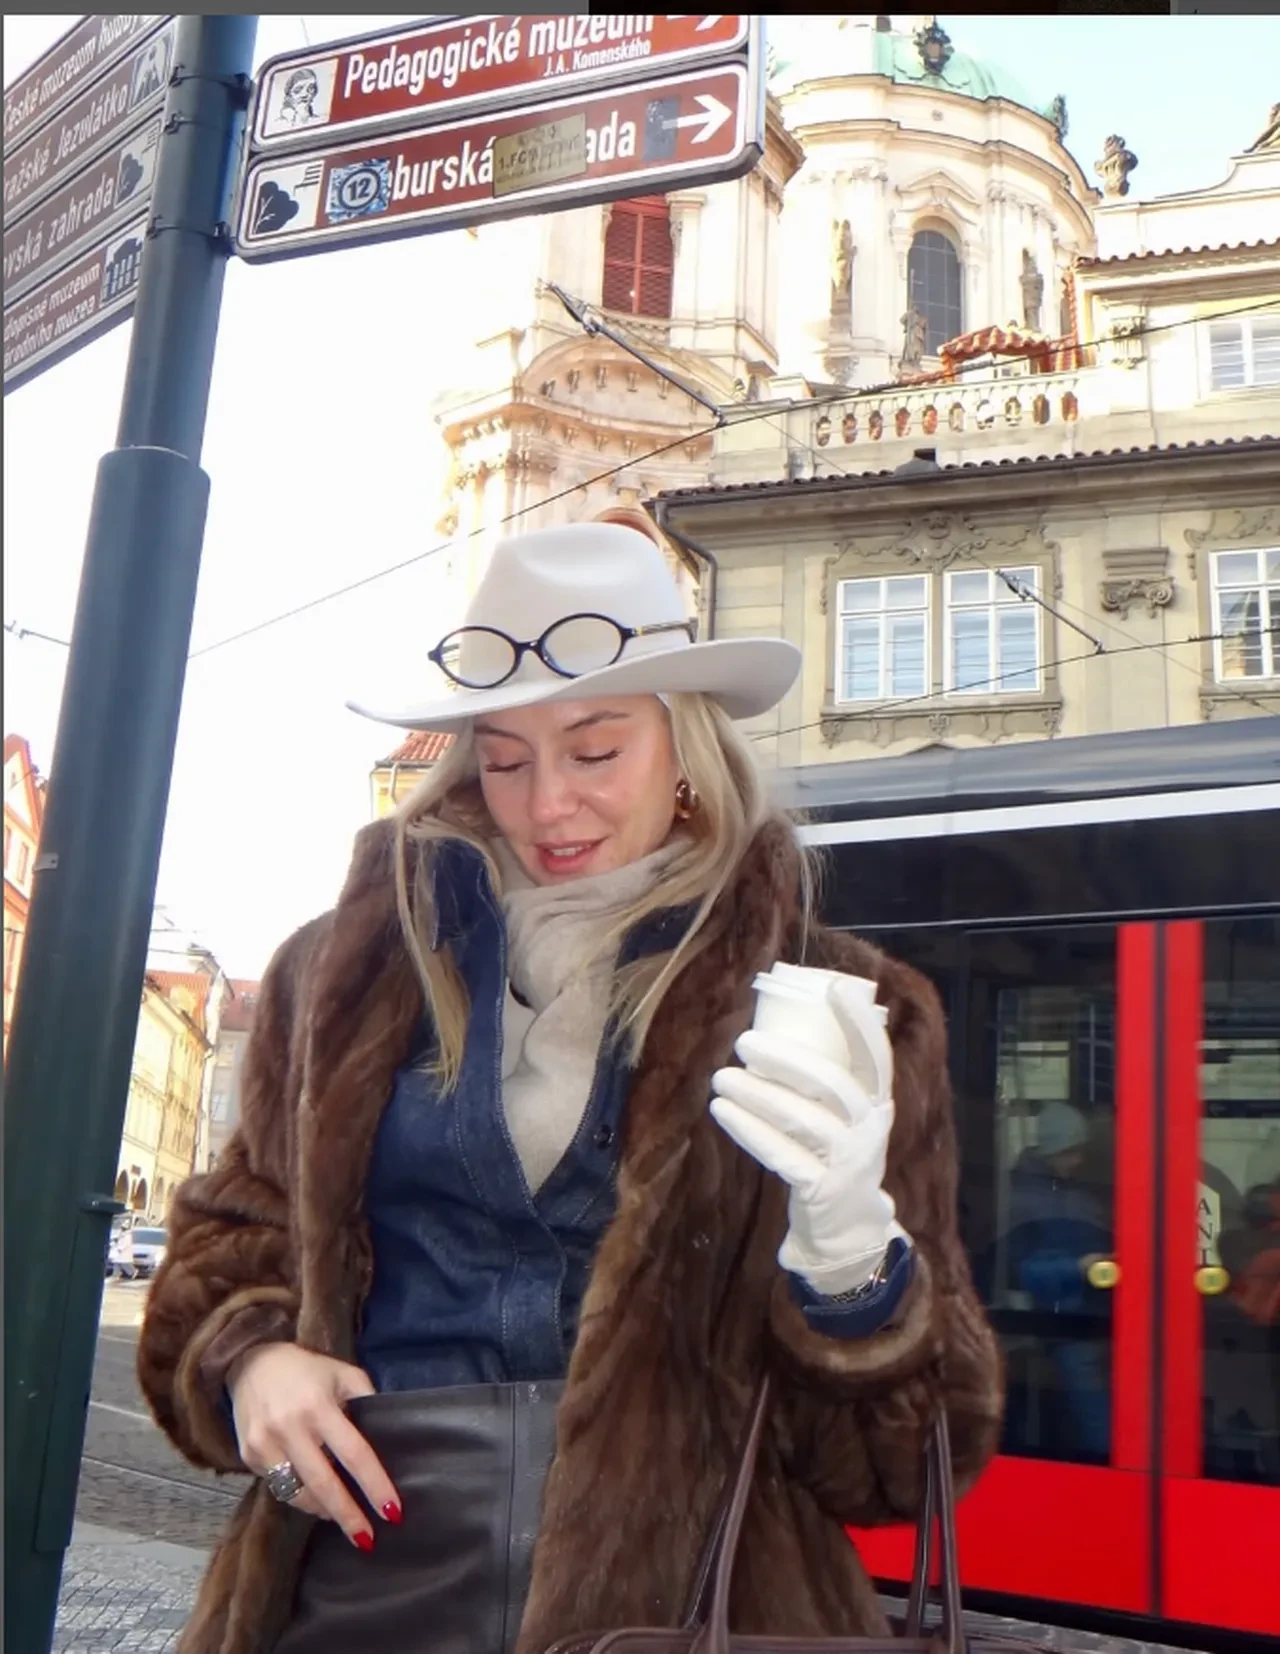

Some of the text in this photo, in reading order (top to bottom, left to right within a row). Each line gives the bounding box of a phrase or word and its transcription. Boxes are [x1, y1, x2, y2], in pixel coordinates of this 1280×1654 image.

[343, 16, 522, 98] Pedagogické
[573, 36, 651, 71] Komenského
[347, 178, 371, 201] 12
[386, 136, 497, 202] burská
[47, 172, 114, 249] zahrada
[48, 262, 100, 312] muzeum
[54, 294, 96, 336] muzea
